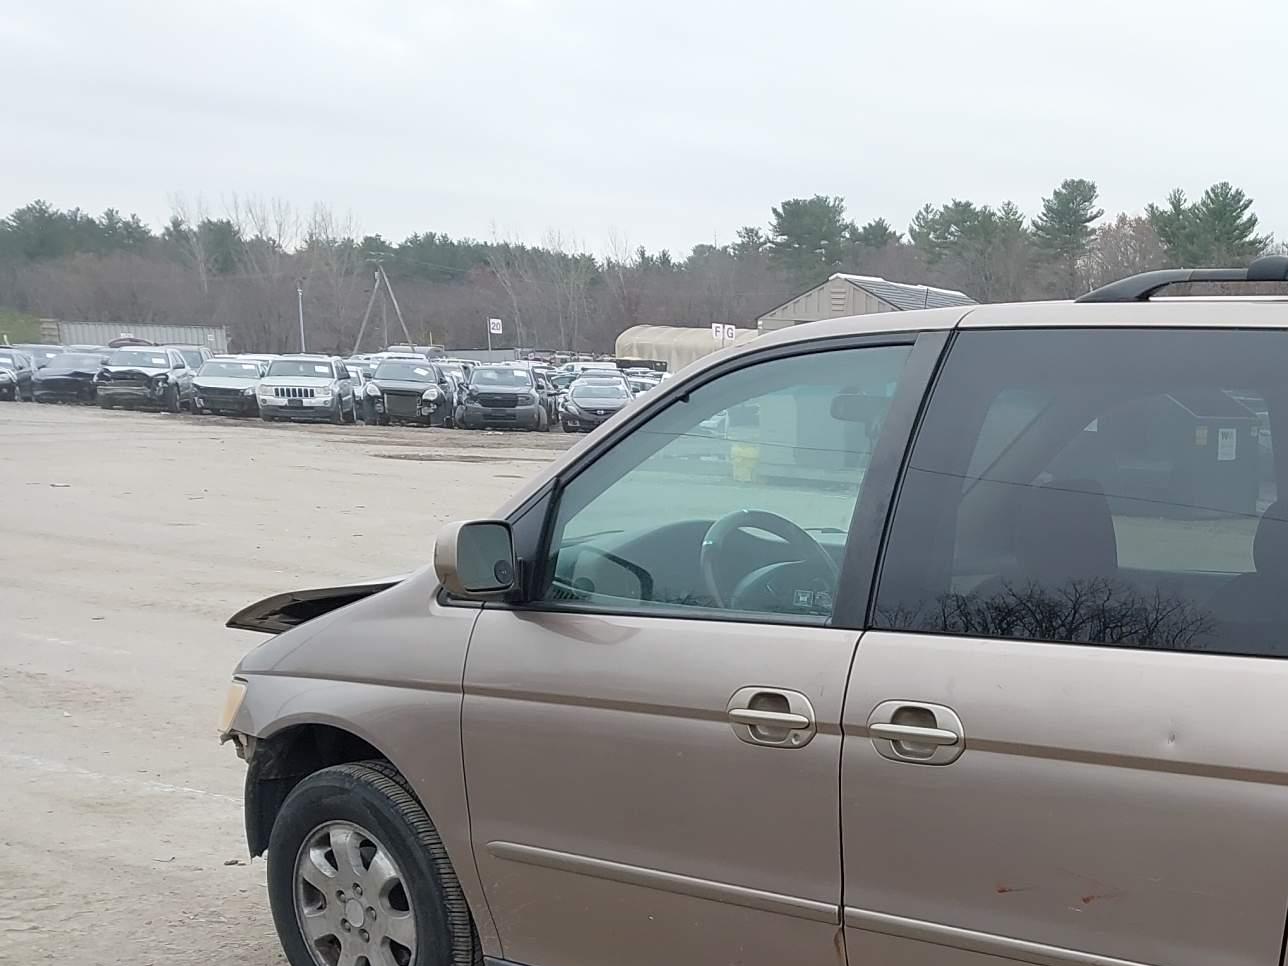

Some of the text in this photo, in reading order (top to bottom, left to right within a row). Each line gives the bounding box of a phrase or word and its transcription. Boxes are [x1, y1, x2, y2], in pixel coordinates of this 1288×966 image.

[491, 321, 501, 331] 20
[715, 326, 721, 337] F
[726, 327, 734, 339] G
